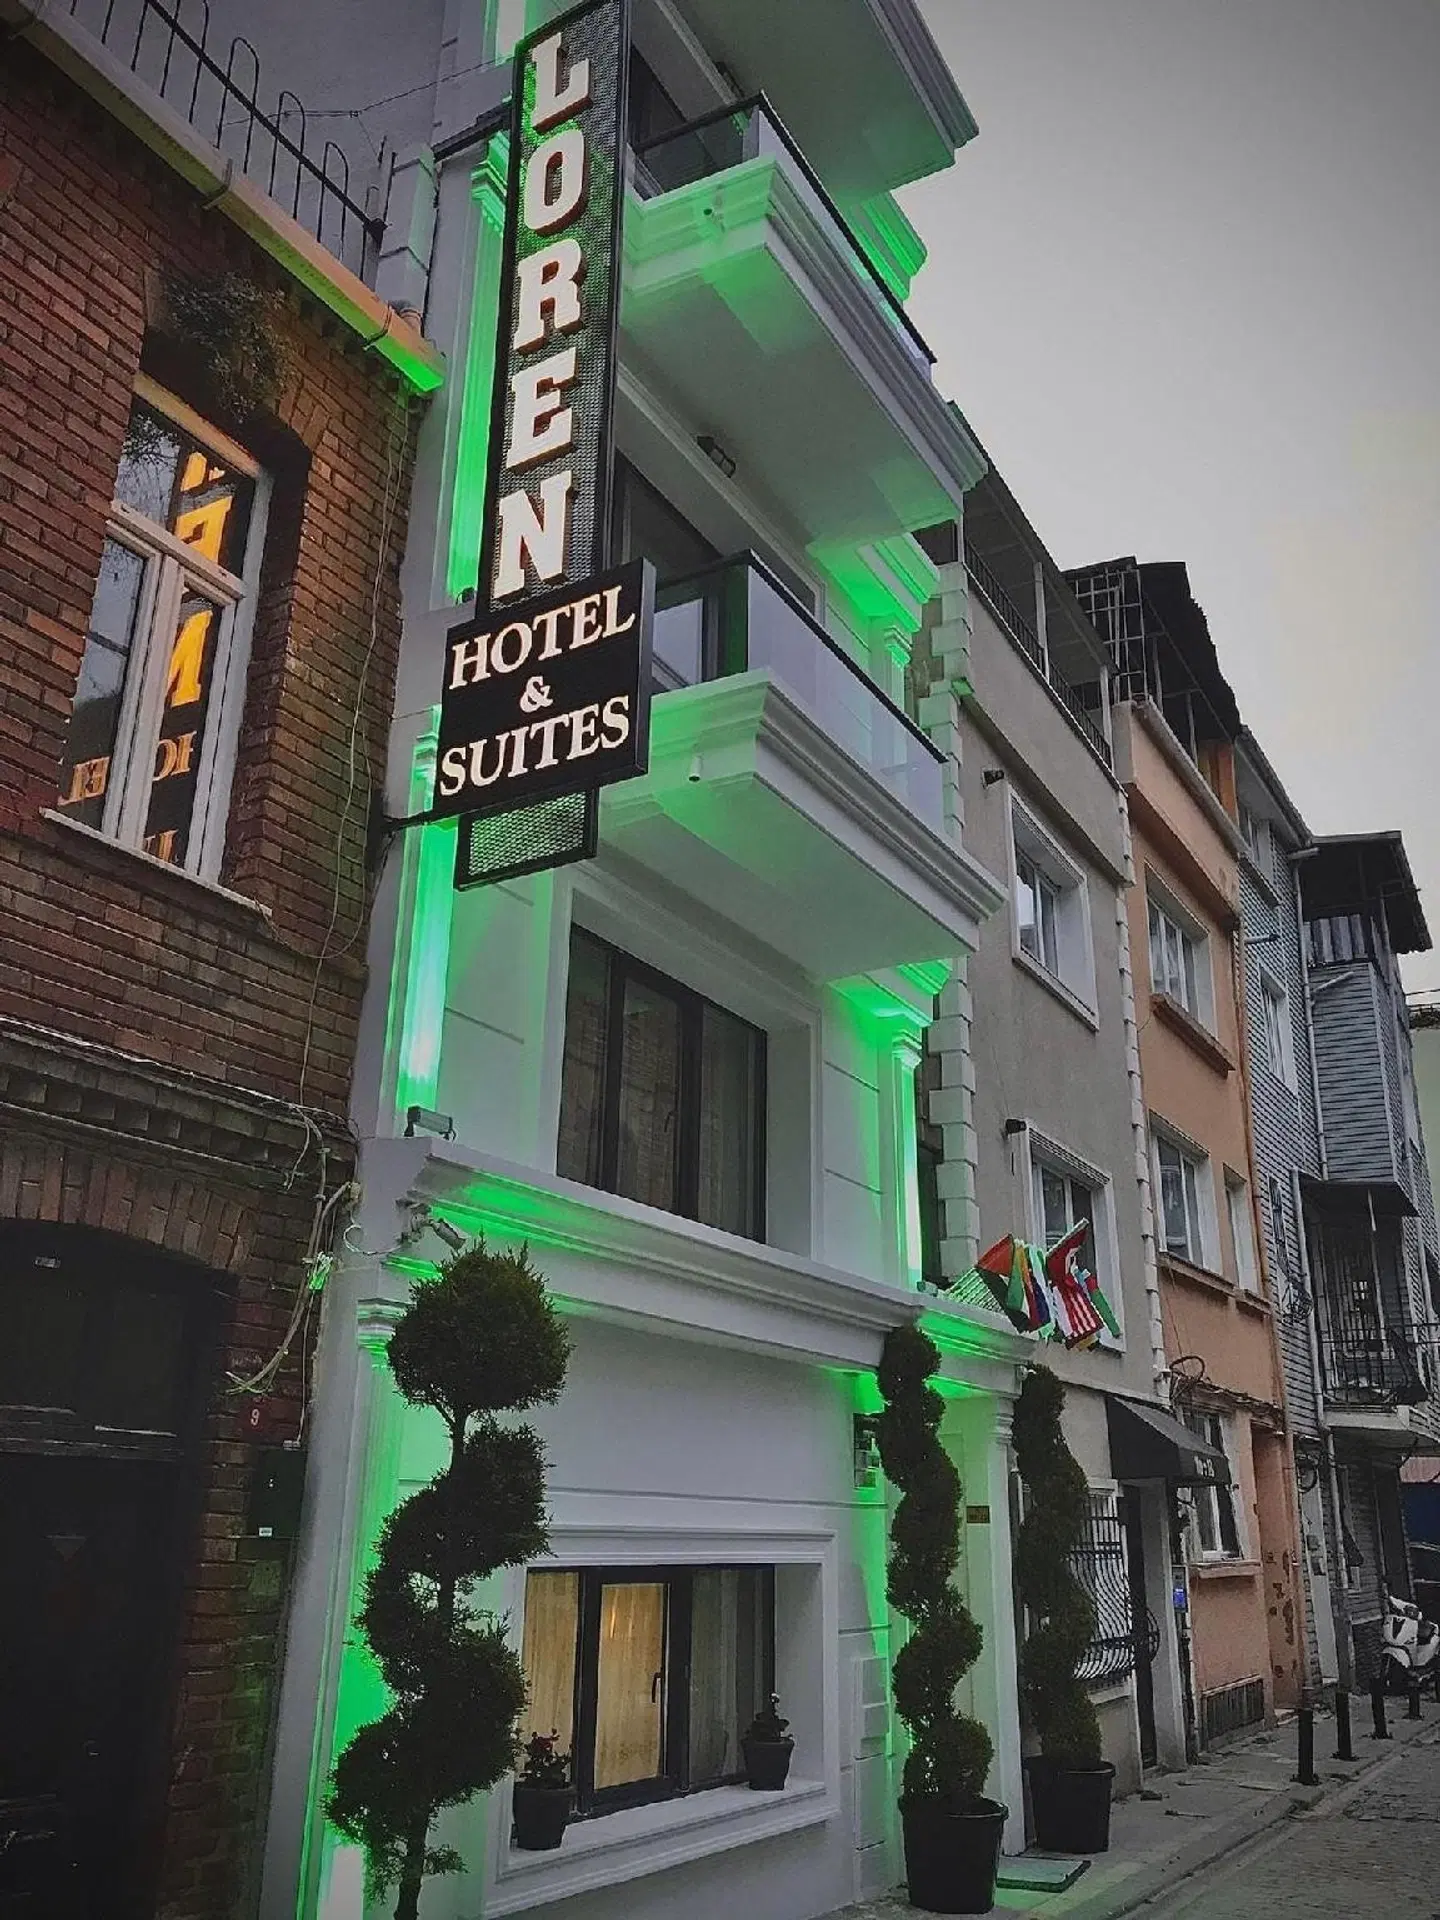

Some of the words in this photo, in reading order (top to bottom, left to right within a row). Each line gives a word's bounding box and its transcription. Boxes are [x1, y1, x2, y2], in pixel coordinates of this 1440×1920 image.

[493, 32, 591, 599] LOREN
[448, 585, 636, 690] HOTEL
[439, 694, 630, 797] SUITES
[519, 675, 554, 714] &
[250, 1408, 260, 1426] 9
